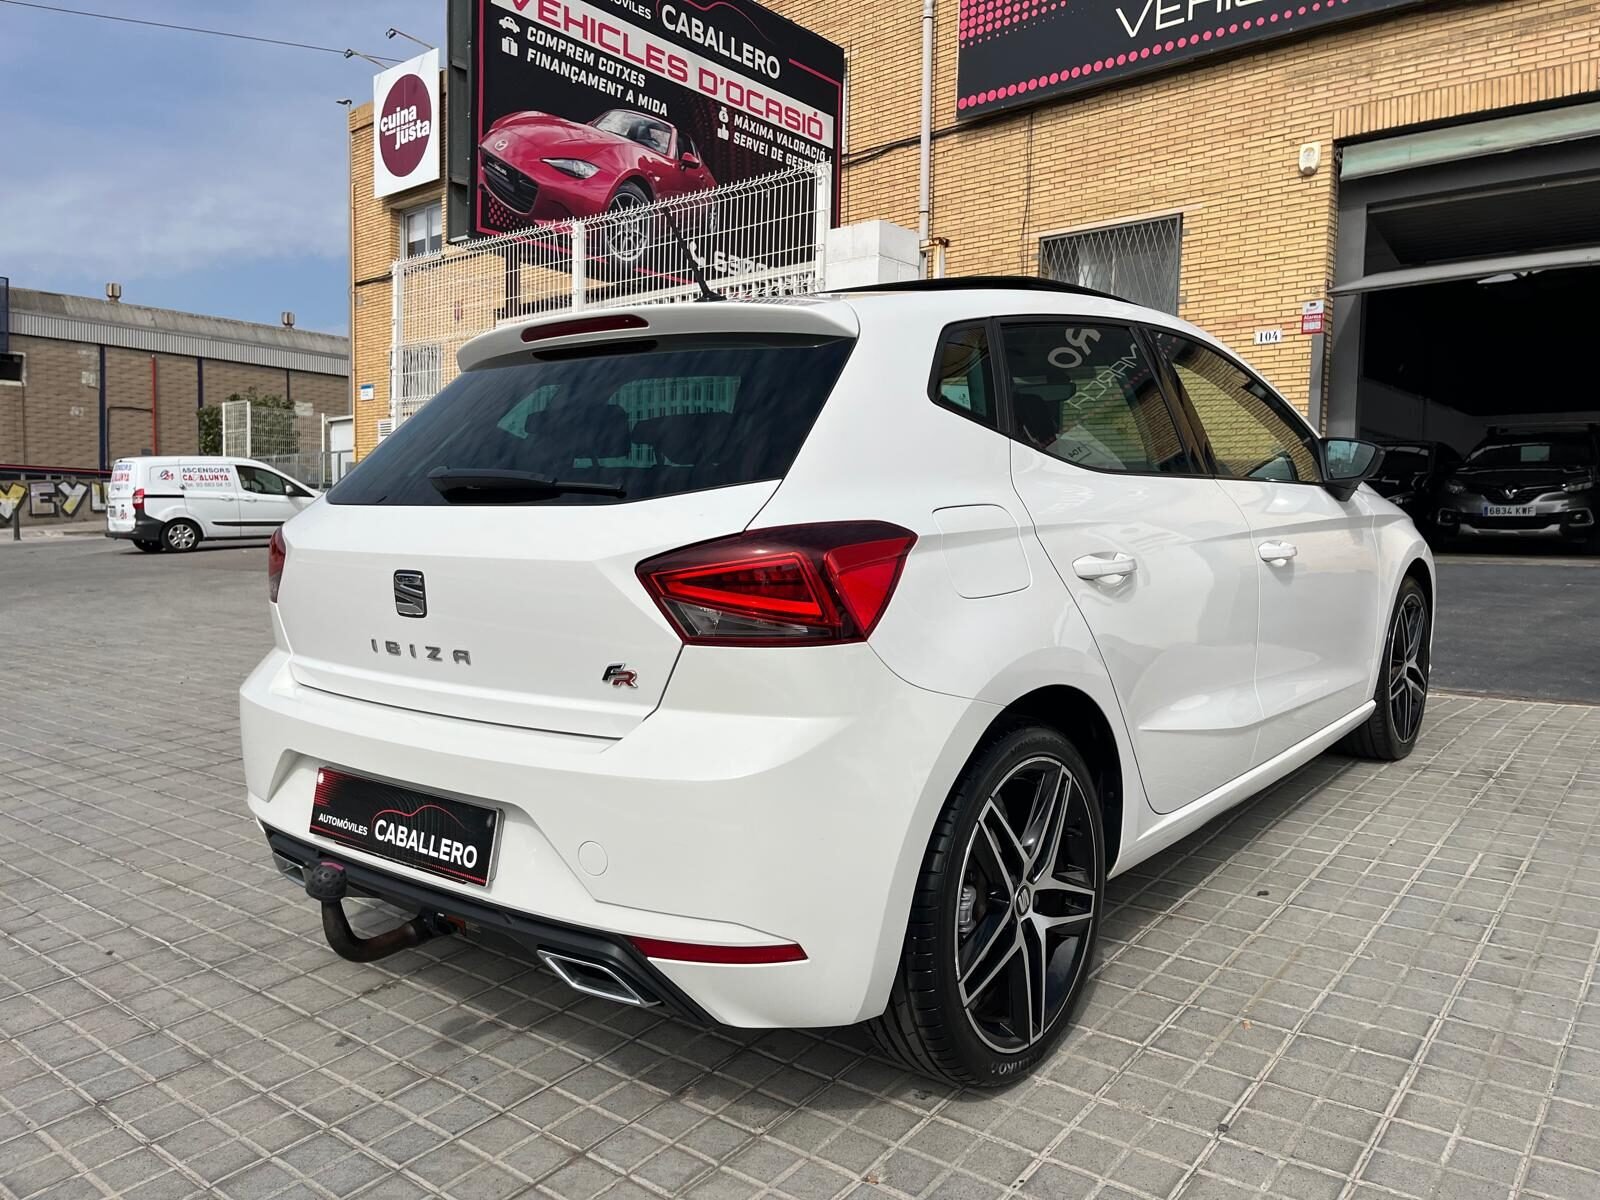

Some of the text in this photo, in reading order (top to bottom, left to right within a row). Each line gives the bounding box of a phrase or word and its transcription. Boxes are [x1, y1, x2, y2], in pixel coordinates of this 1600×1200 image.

[526, 26, 646, 88] COMPREM COTXES
[661, 4, 781, 80] CABALLERO
[511, 0, 823, 141] VEHICLES D'OCASIÓ
[526, 48, 668, 117] FINANÇAMENT A MIDA
[380, 104, 417, 132] cuina
[395, 119, 430, 150] justa
[733, 132, 768, 157] SERVEI
[771, 146, 783, 162] DE
[734, 114, 826, 162] MÀXIMA VALORACIÓ
[1259, 331, 1278, 342] 104
[371, 638, 472, 666] IBIZA
[602, 663, 639, 689] FR
[318, 812, 478, 869] AUTOMÓVILES CABALLERO
